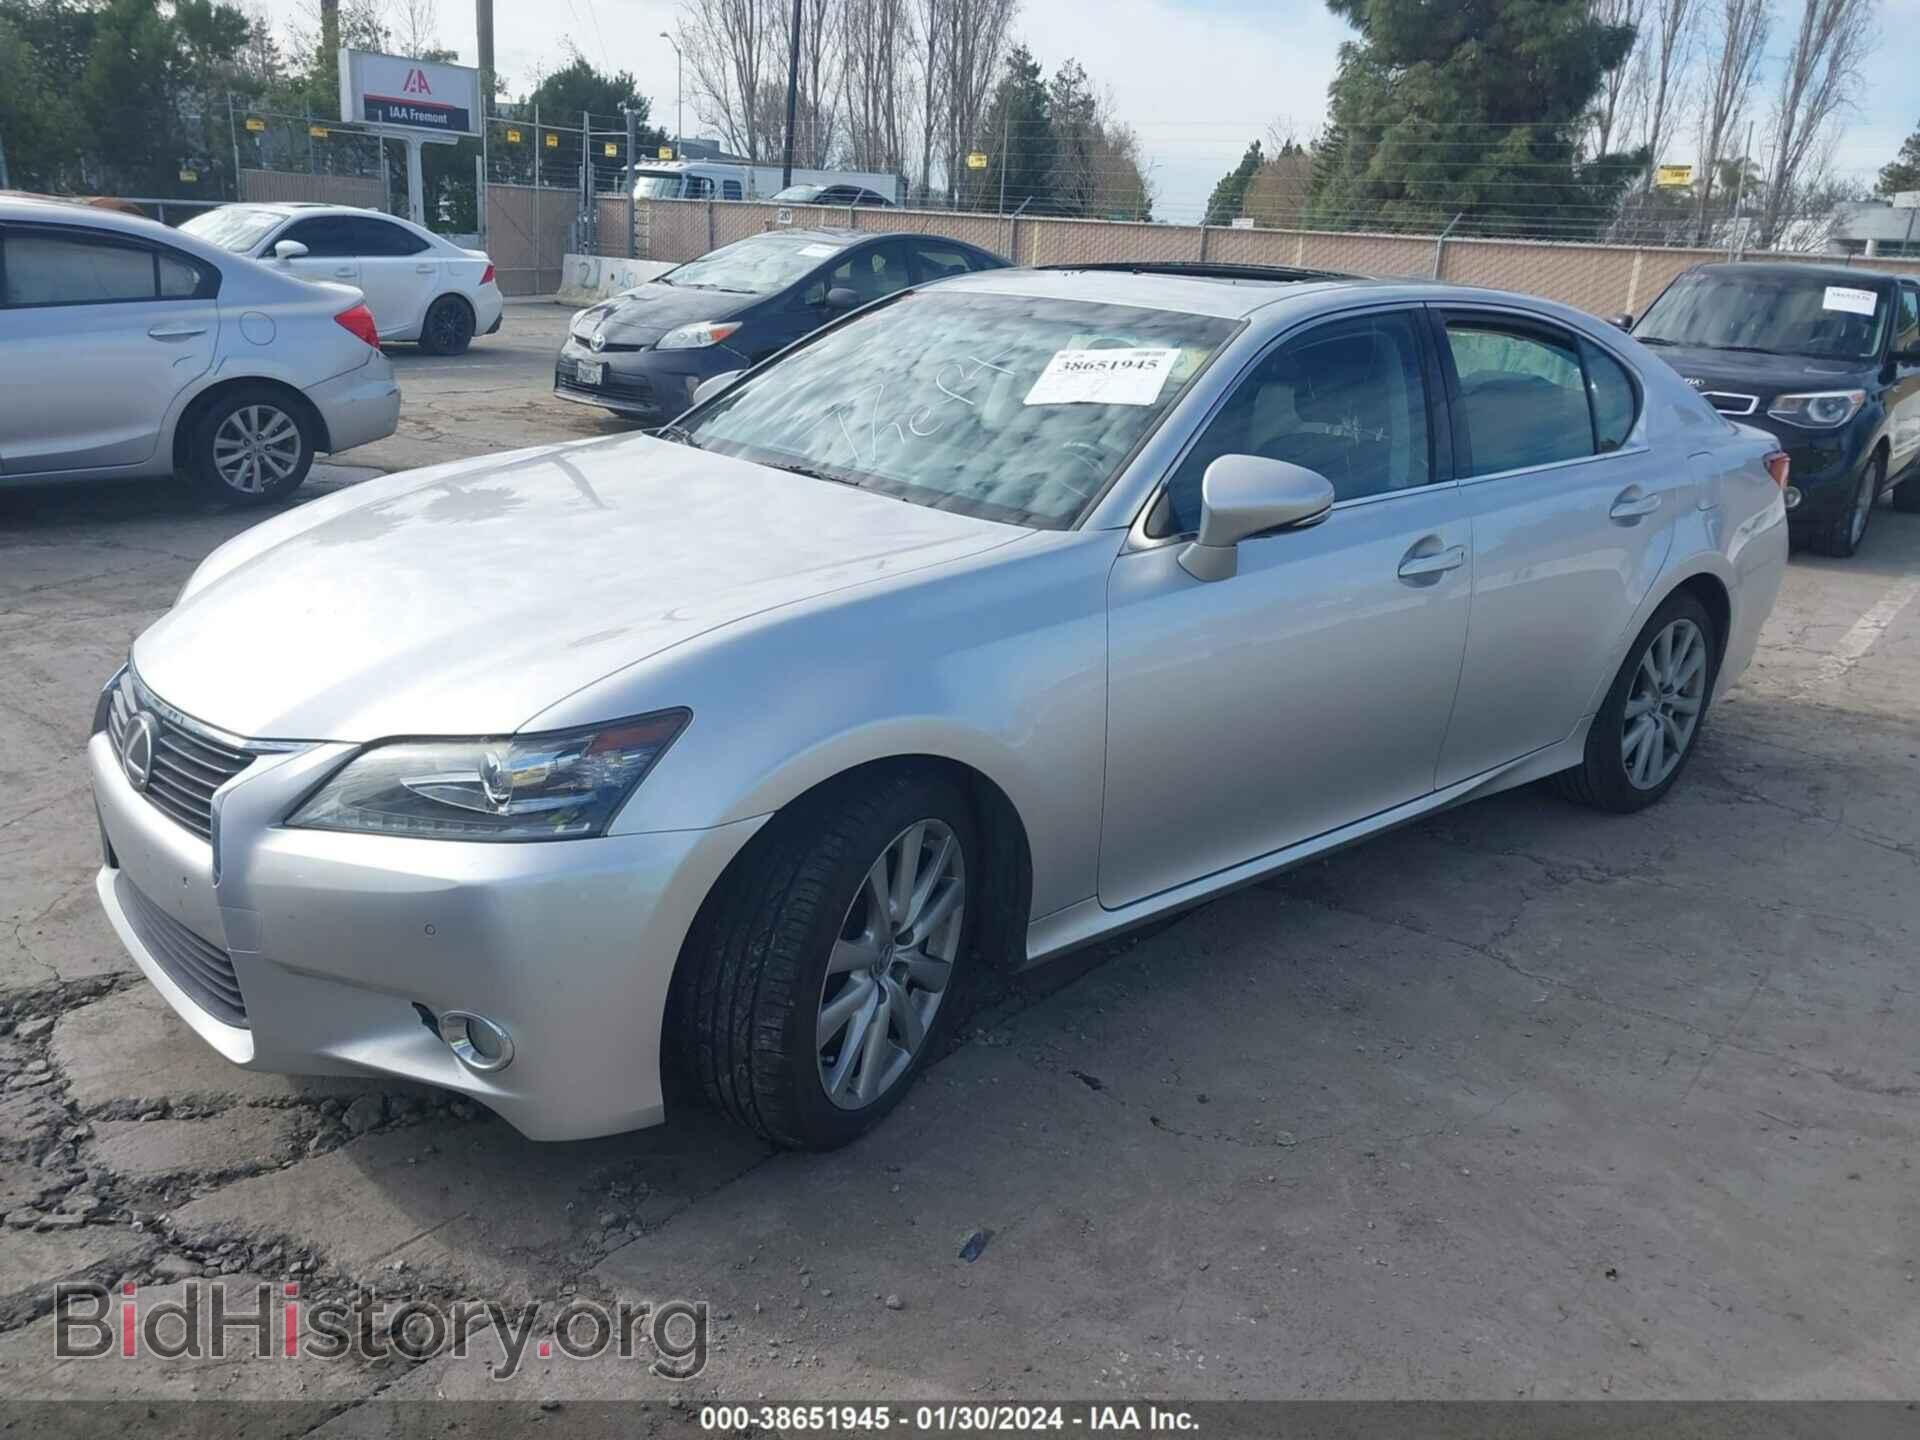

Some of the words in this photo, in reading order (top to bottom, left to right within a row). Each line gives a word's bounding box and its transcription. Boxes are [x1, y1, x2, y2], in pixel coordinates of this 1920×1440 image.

[389, 106, 408, 121] IAA
[409, 109, 448, 124] Fremont
[1063, 359, 1160, 371] 38651945
